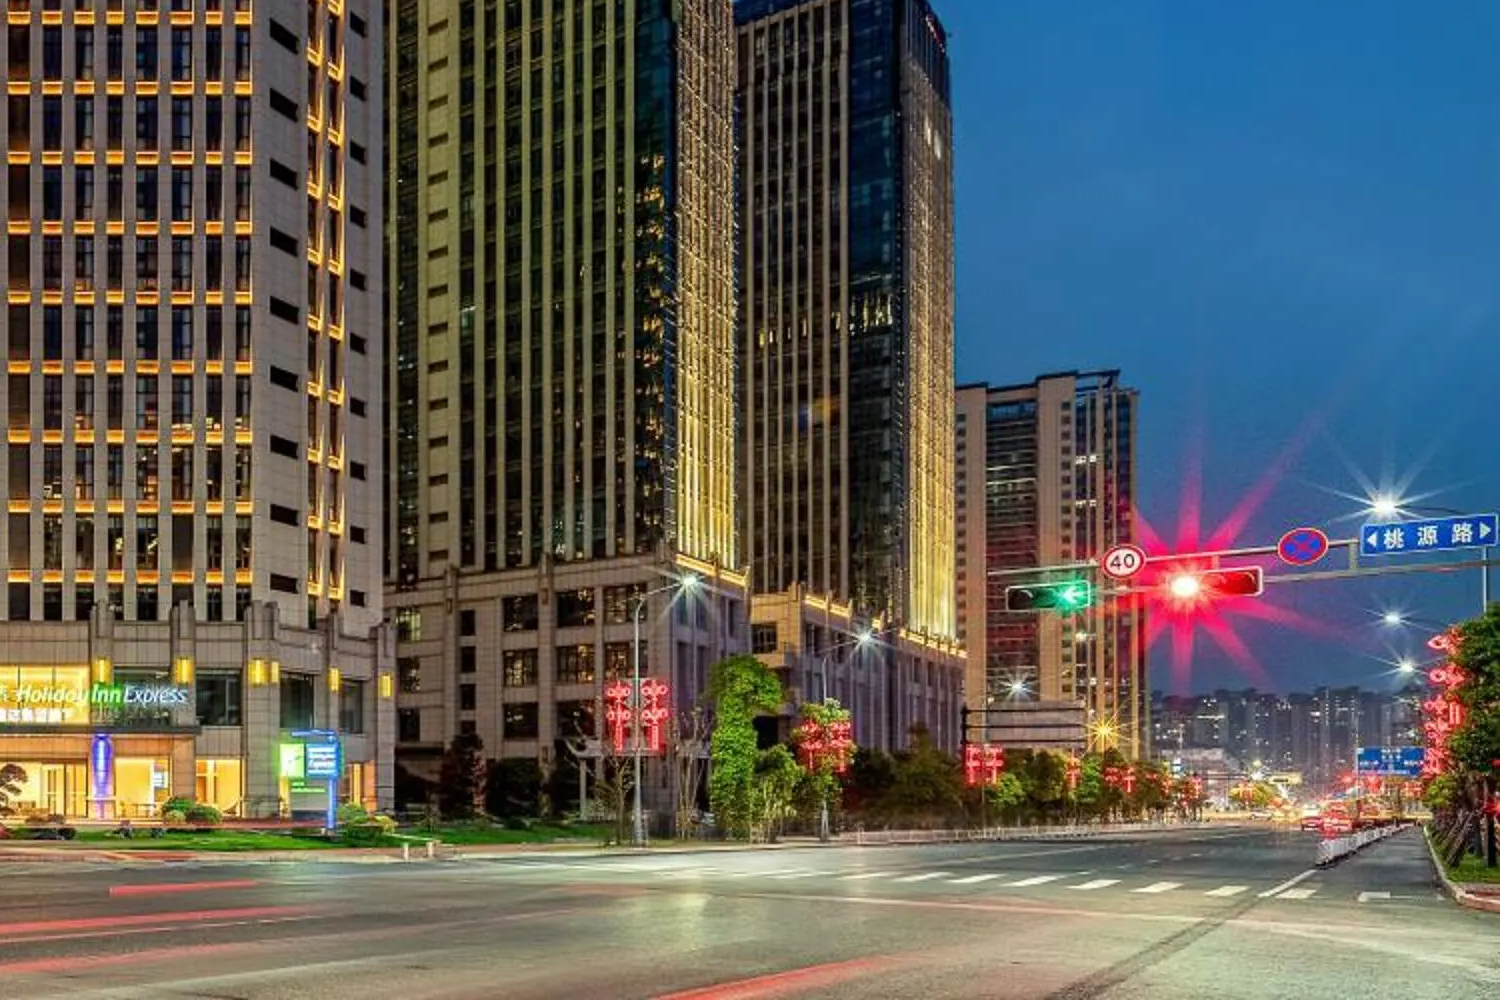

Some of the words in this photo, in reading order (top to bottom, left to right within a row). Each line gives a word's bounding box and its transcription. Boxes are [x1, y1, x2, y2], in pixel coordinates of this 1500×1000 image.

[1383, 522, 1473, 549] 桃源路
[1110, 553, 1135, 570] 40
[13, 683, 90, 707] Holiday
[91, 682, 122, 703] Inn
[123, 682, 188, 707] Express
